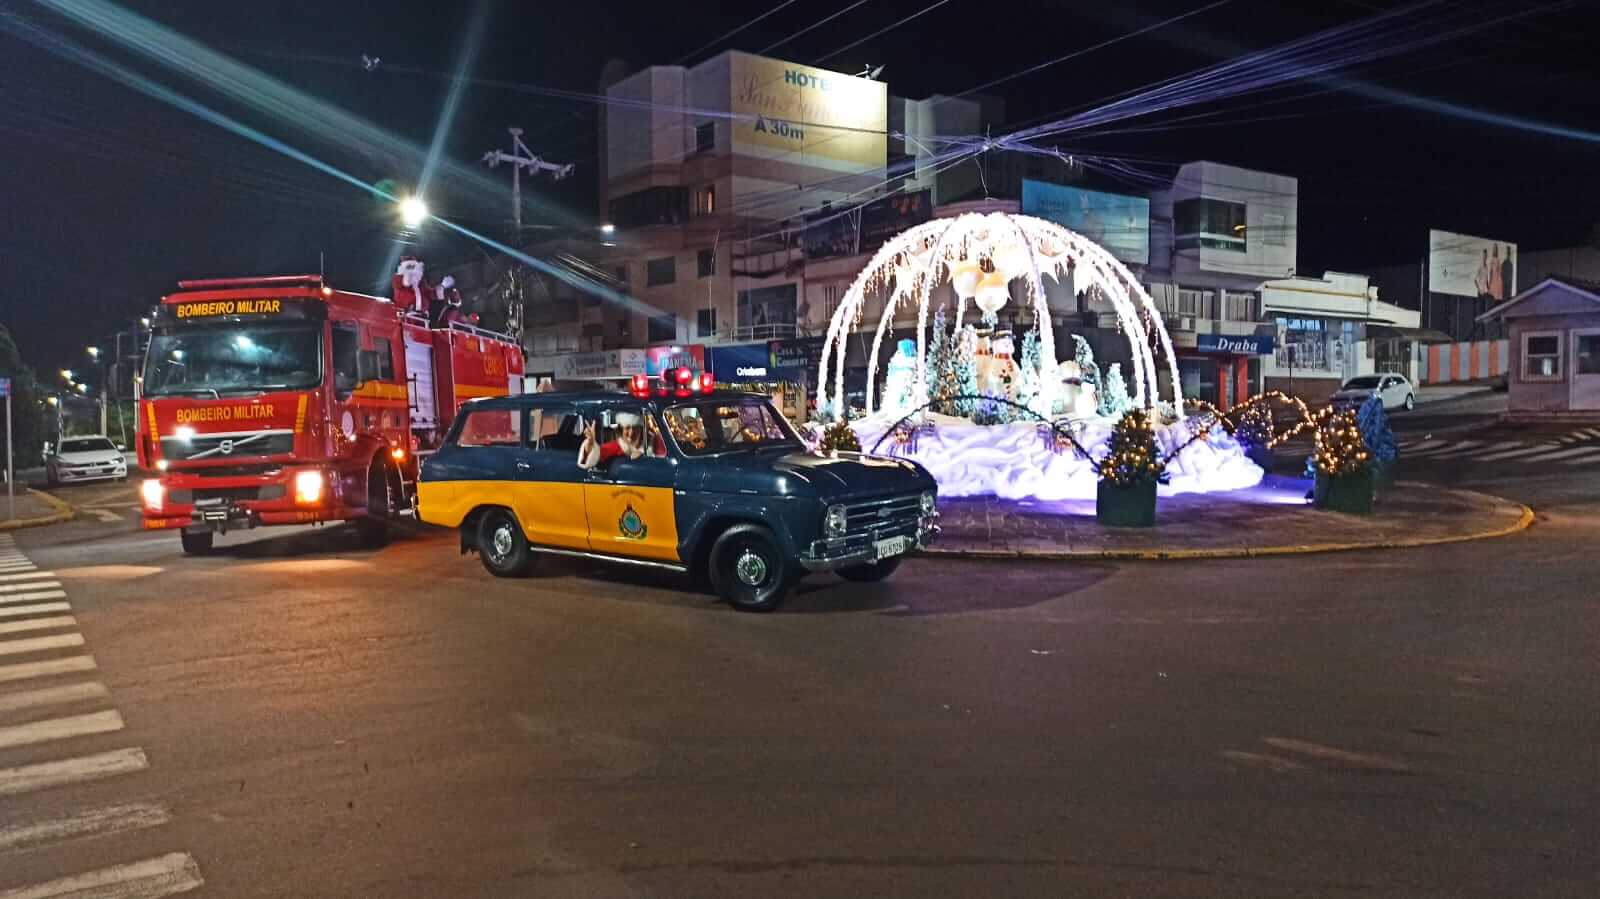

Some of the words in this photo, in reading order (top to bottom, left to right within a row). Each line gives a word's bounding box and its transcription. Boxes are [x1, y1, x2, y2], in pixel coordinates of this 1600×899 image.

[784, 69, 837, 91] HOTE
[770, 119, 804, 141] 30m
[177, 300, 234, 318] BOMBEIRO
[236, 299, 280, 314] MILITAR
[1216, 337, 1259, 352] Draba
[176, 406, 231, 423] BOMBEIRO
[233, 403, 274, 419] MILITAR
